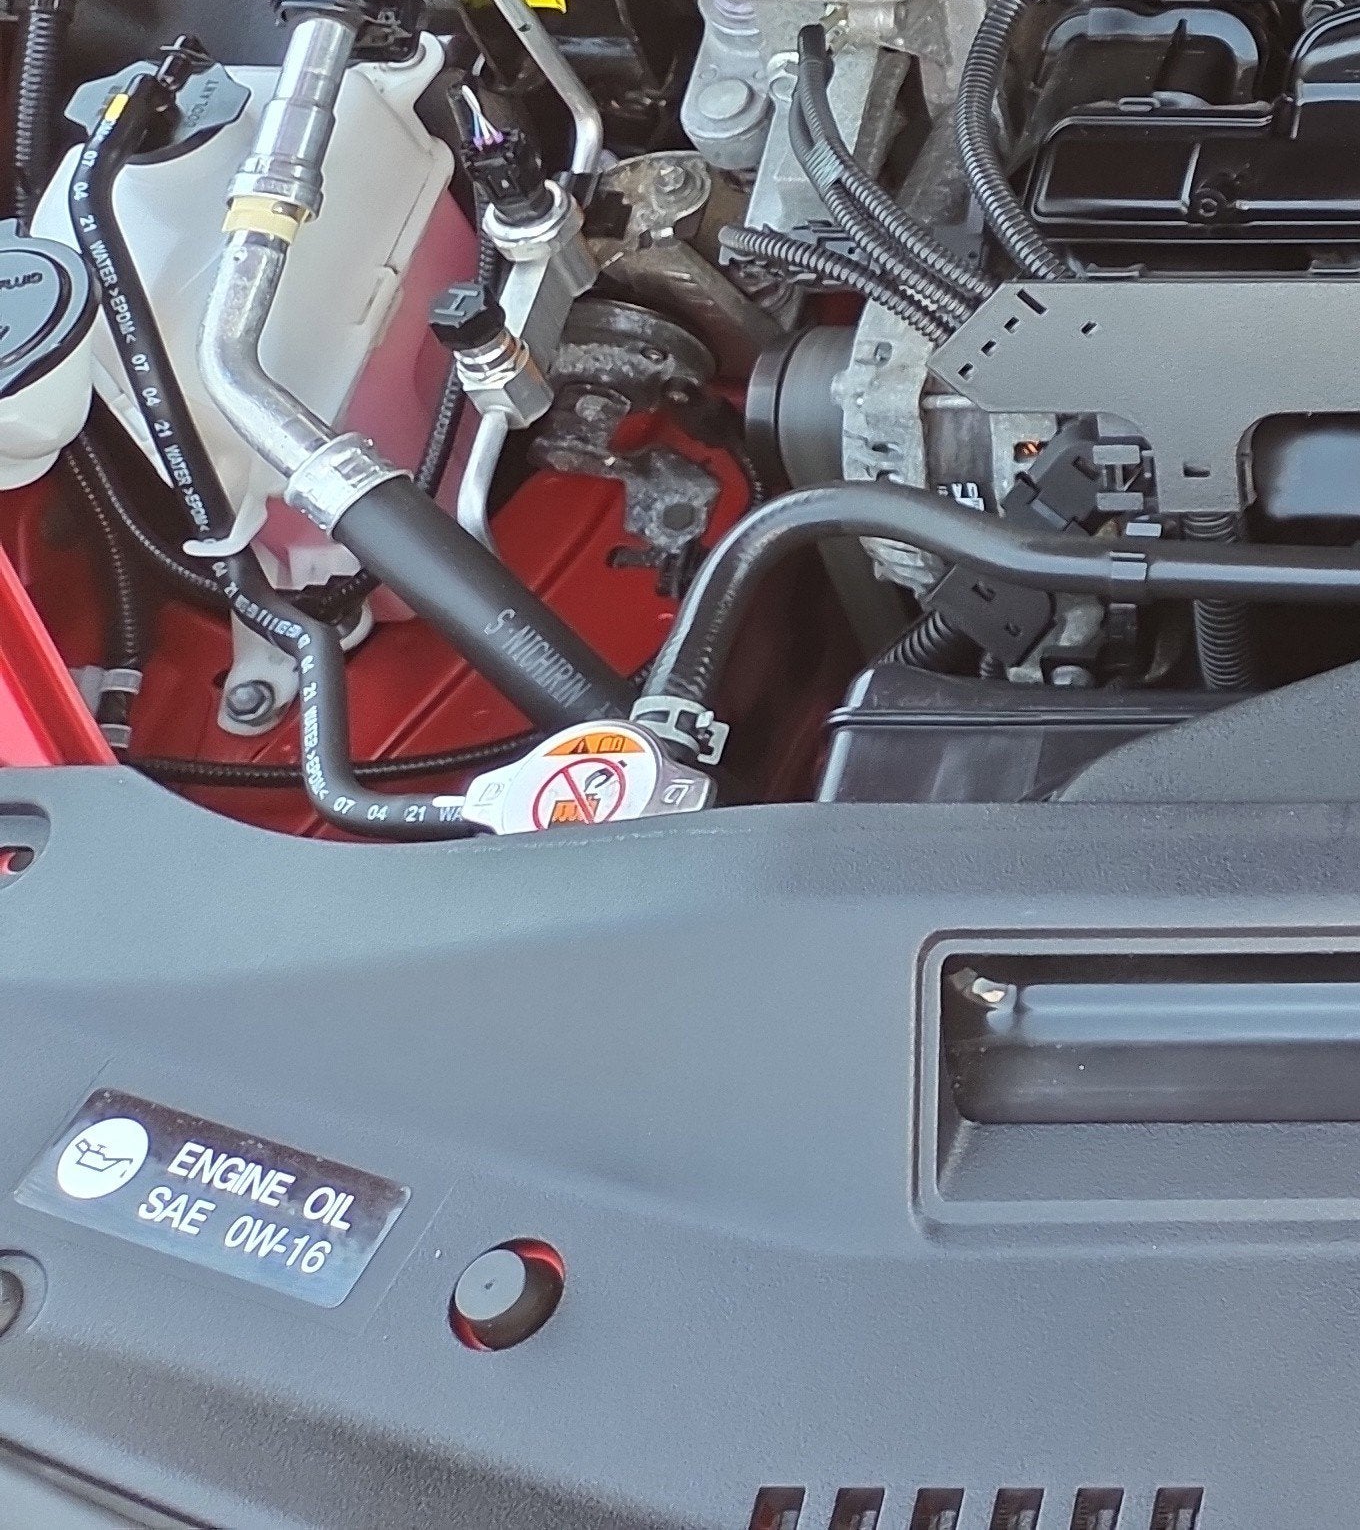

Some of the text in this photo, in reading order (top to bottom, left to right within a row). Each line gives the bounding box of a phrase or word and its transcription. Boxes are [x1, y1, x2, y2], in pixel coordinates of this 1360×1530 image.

[79, 215, 97, 233] 21
[90, 239, 118, 287] WATER
[131, 353, 150, 372] 07
[154, 420, 174, 438] 21
[164, 444, 194, 487] WATER
[333, 796, 357, 815] 07
[367, 804, 389, 821] 04
[404, 805, 427, 823] 21
[138, 1186, 332, 1274] SAE 0W-16
[167, 1140, 355, 1231] ENGINE OIL
